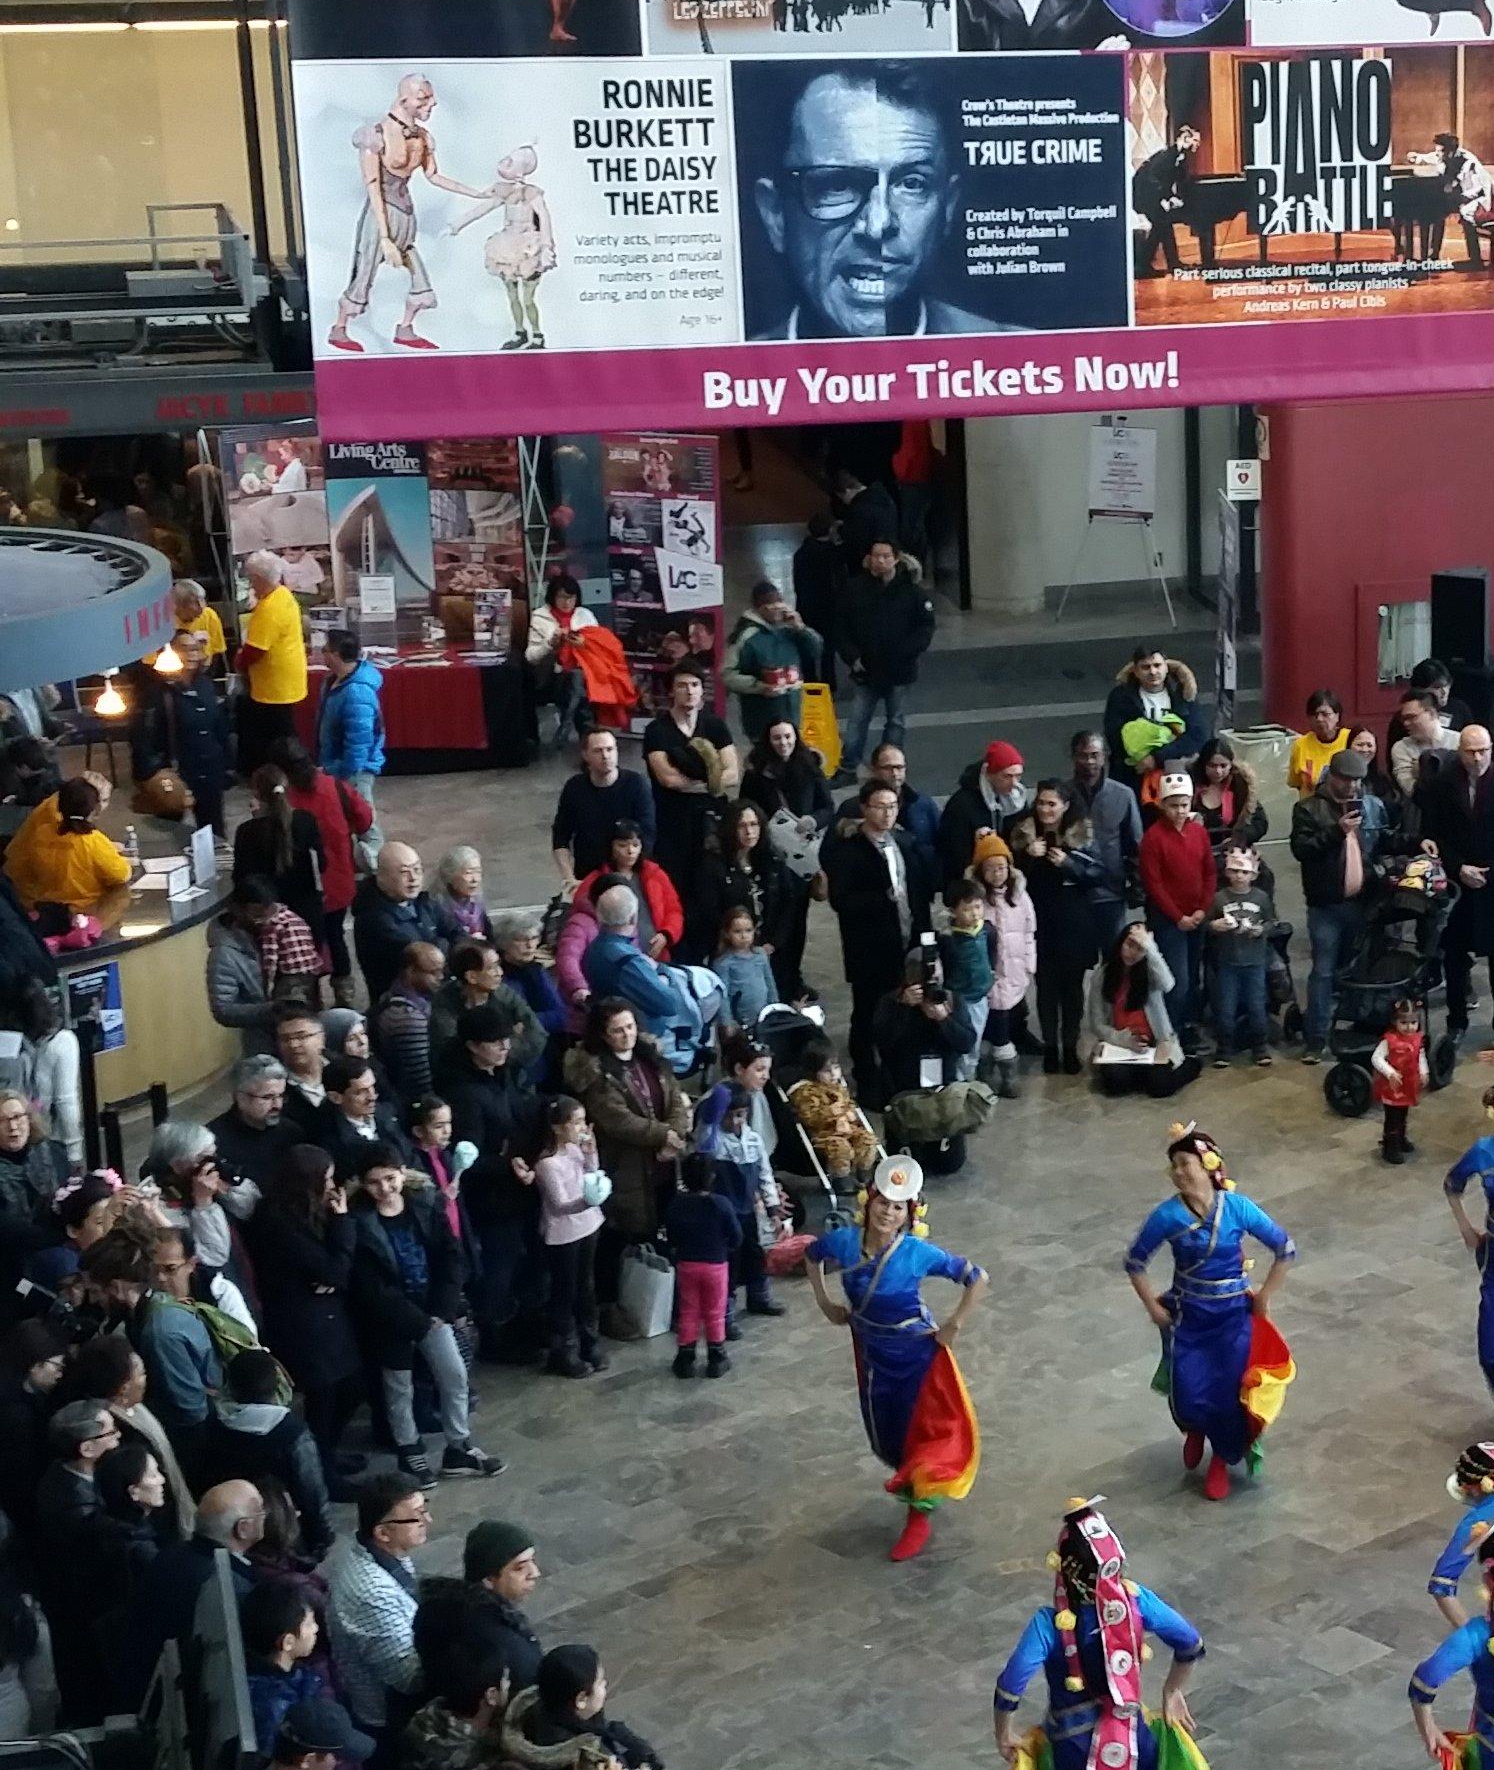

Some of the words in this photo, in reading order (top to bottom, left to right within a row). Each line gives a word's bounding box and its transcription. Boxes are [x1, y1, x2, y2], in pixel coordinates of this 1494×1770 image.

[672, 2, 701, 20] LED
[603, 80, 713, 108] RONNIE
[1241, 59, 1393, 165] PIANO
[574, 119, 714, 148] BURKETT
[1031, 139, 1101, 164] CRIME
[587, 158, 637, 182] THE
[645, 156, 716, 181] DAISY
[604, 191, 718, 216] THEATRE
[1246, 165, 1393, 234] BATTLE
[704, 371, 786, 415] Buy
[797, 368, 896, 404] Your
[906, 359, 1064, 399] Tickets
[1074, 350, 1180, 392] Now!
[329, 444, 374, 460] Living
[376, 443, 407, 456] Arts
[371, 455, 420, 470] Centre
[669, 564, 697, 589] LAC
